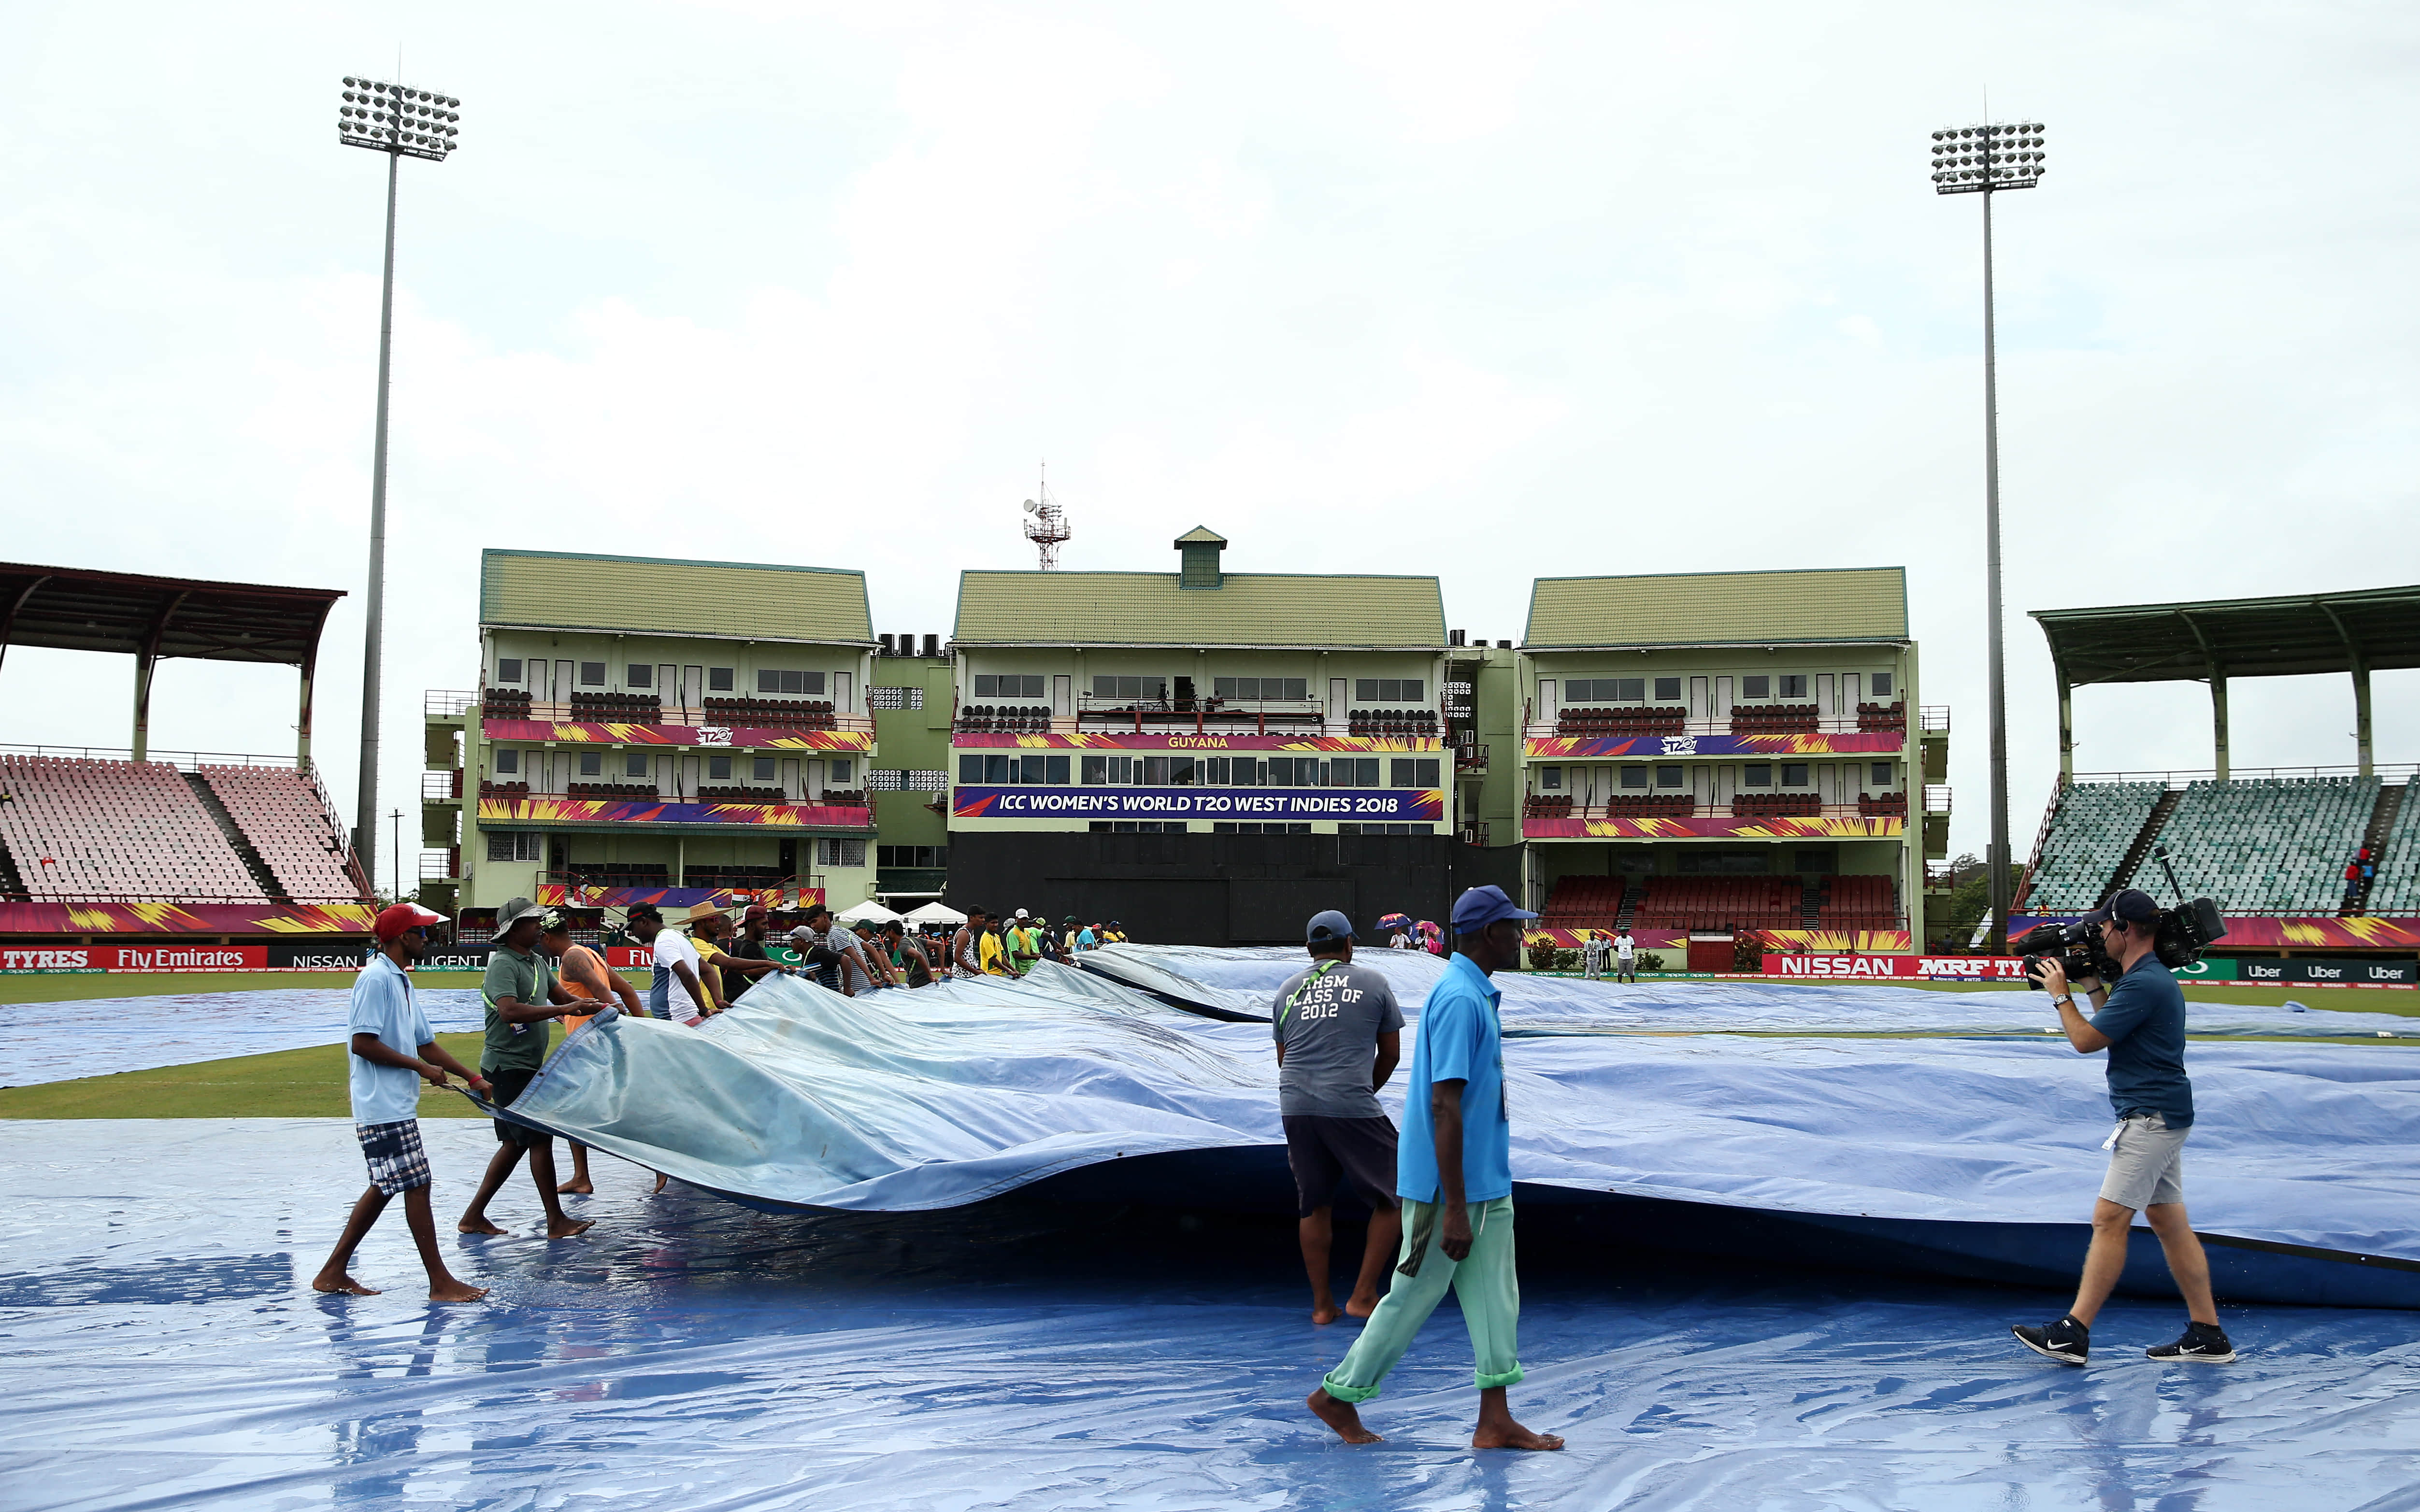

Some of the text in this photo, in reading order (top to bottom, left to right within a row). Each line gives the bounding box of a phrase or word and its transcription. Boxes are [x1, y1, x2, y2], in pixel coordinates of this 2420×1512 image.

[1168, 737, 1229, 748] GUYANA
[999, 795, 1398, 813] ICC WOMEN'S WORLD T20 WEST INDIES 2018
[3, 951, 88, 968] TYRES
[118, 948, 243, 968] Fly Emirates
[293, 956, 358, 968] NISSAN
[1782, 957, 1893, 975] NISSAN
[1917, 959, 1990, 975] MRF
[2248, 966, 2281, 977] Uber
[2307, 966, 2341, 978] Uber
[2369, 967, 2404, 979] Uber
[1341, 988, 1363, 1003] OF
[1301, 1003, 1339, 1020] 2012
